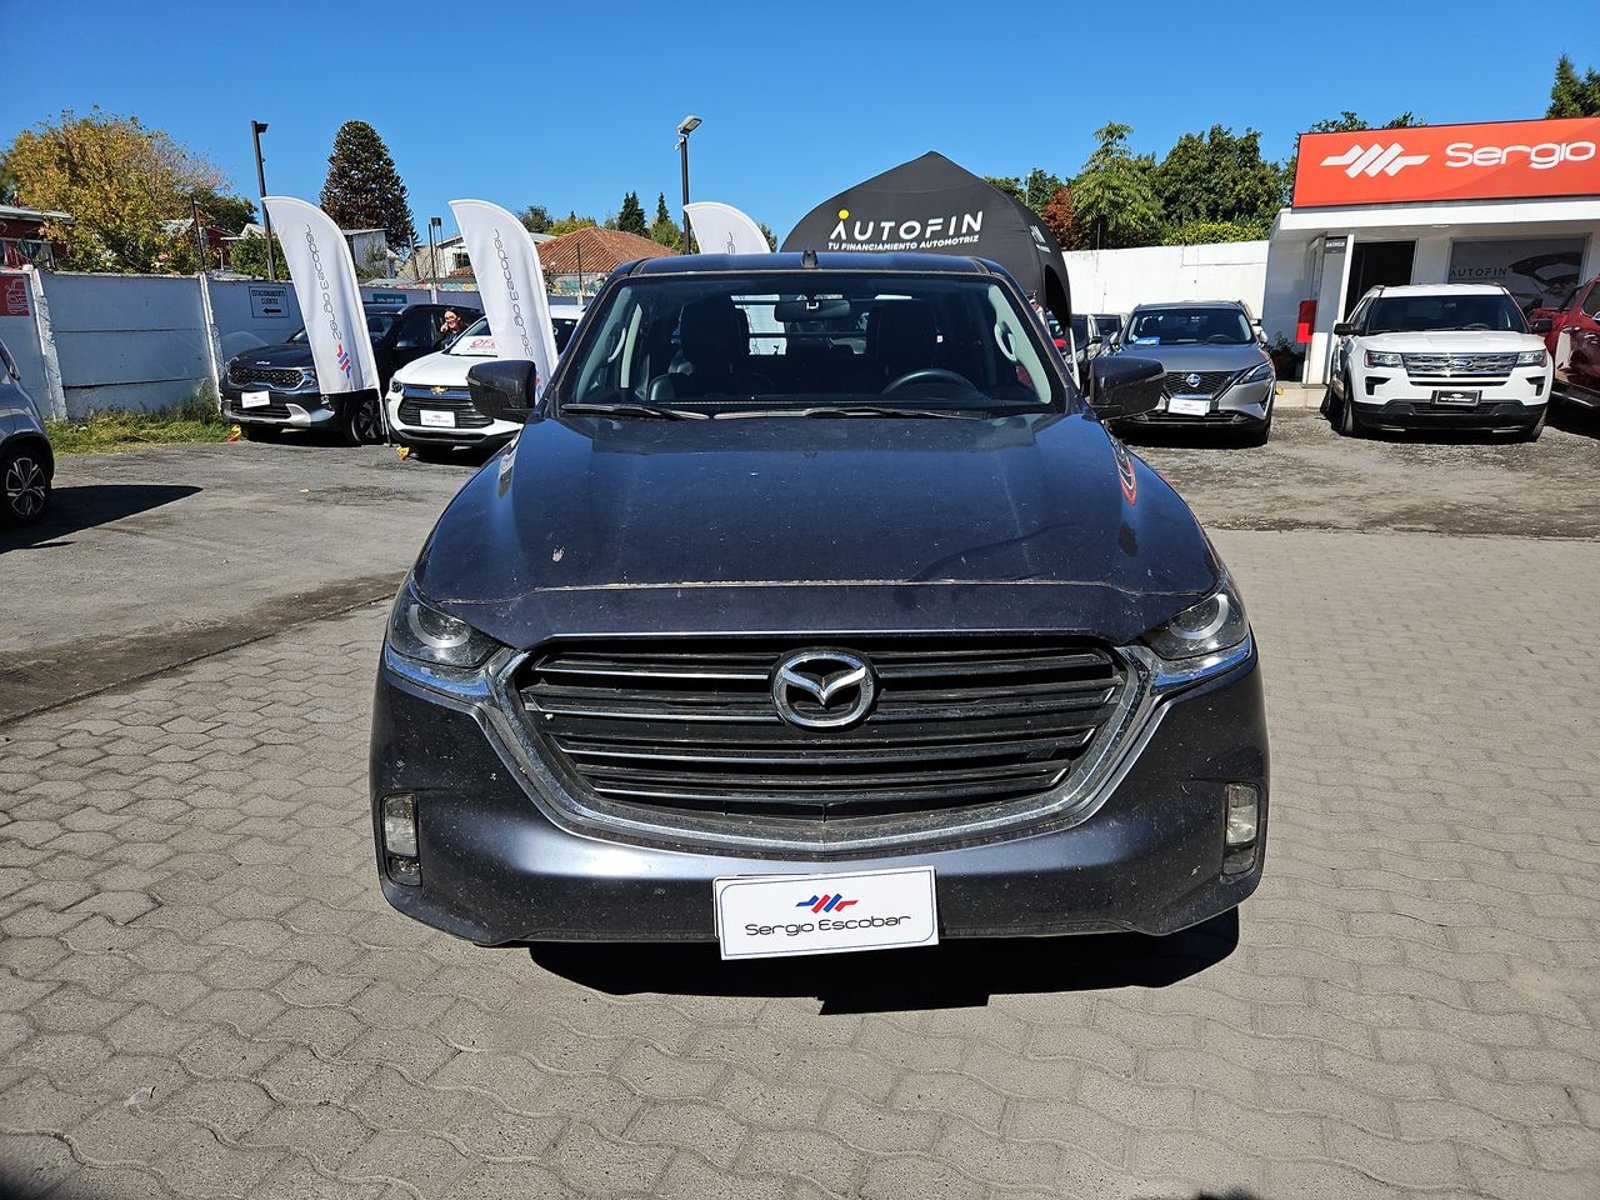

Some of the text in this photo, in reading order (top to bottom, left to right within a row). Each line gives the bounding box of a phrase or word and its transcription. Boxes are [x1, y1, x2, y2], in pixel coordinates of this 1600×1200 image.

[1445, 141, 1596, 170] Sergio
[829, 209, 983, 241] AUTOFIN
[828, 235, 980, 251] TU FINANCIAMIENTO AUTOMOTRIZ
[1450, 266, 1507, 278] AUTOFIN
[745, 915, 912, 937] Sergio Escobar
